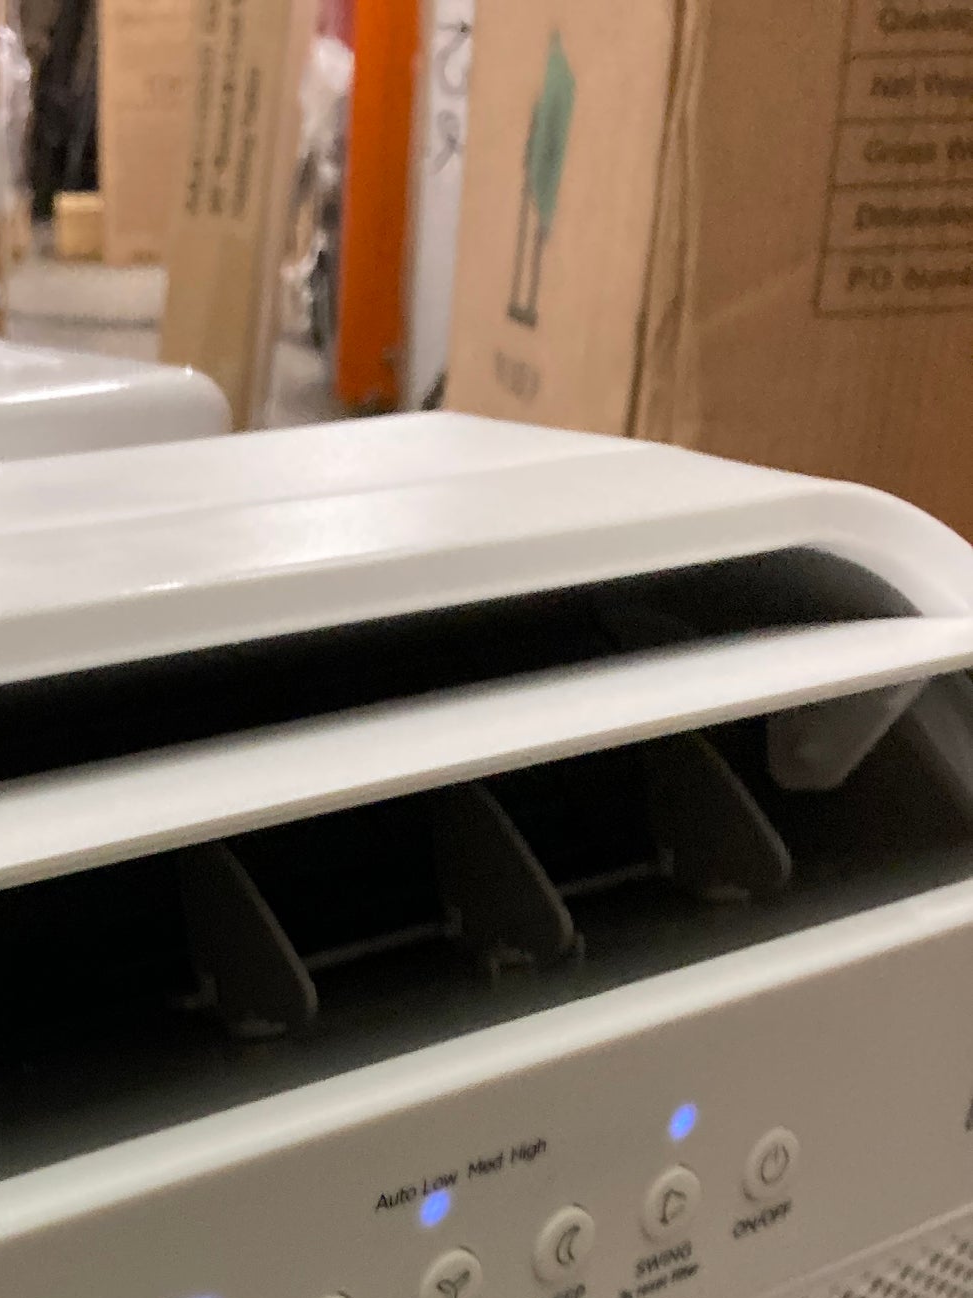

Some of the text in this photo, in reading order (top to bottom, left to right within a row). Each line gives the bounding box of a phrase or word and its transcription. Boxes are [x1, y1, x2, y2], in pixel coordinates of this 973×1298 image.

[375, 1187, 417, 1213] Auto
[422, 1171, 458, 1197] Low
[511, 1137, 547, 1164] High
